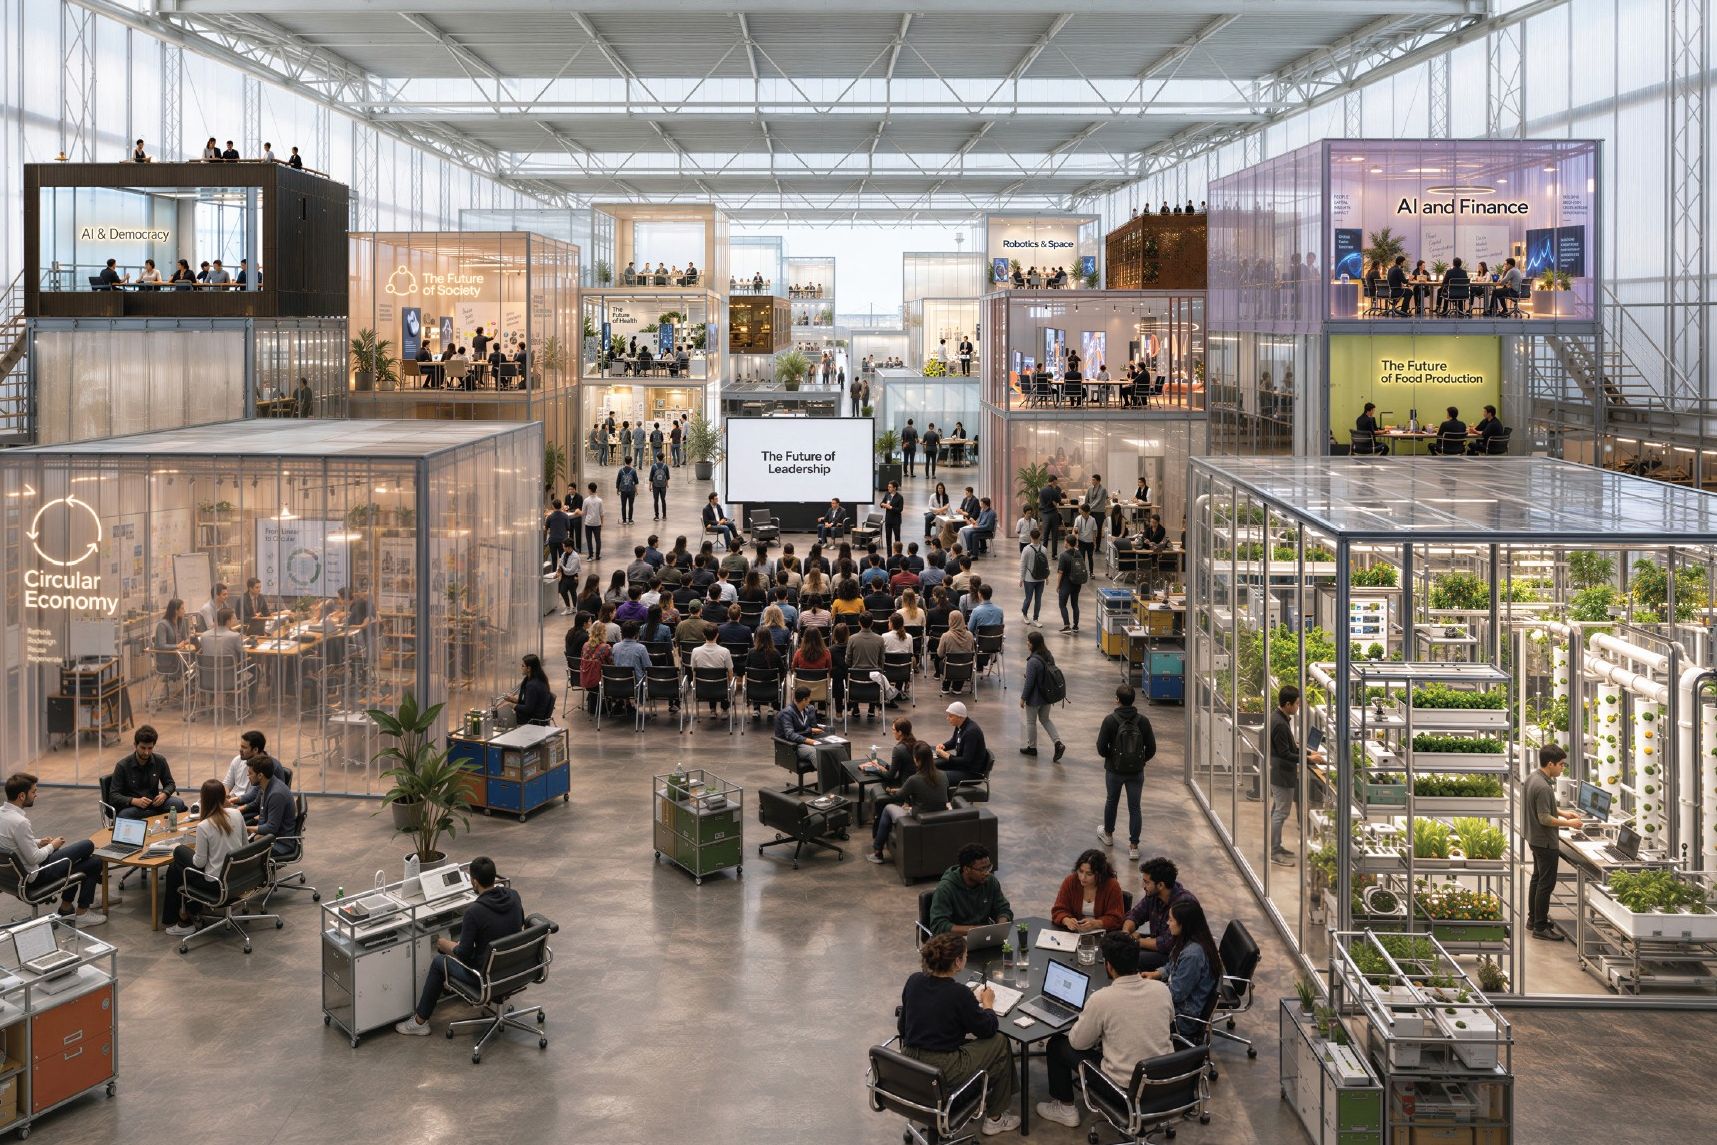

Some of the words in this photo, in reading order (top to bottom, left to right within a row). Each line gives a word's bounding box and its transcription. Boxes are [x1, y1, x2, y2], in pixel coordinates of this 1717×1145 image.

[1397, 198, 1417, 214] AI
[1422, 198, 1454, 214] and
[1459, 198, 1529, 214] Finance
[81, 228, 94, 240] AI
[97, 228, 106, 240] &
[109, 228, 170, 243] Democracy
[1003, 240, 1039, 248] Robotics
[1040, 240, 1047, 248] &
[1048, 240, 1074, 250] Space
[423, 273, 444, 284] The
[447, 273, 485, 284] Future
[422, 285, 436, 296] of
[437, 285, 481, 298] Society
[1381, 360, 1405, 371] The
[1407, 360, 1448, 371] Future
[1380, 373, 1393, 384] of
[1395, 373, 1423, 384] Food
[1425, 373, 1484, 384] Production
[761, 450, 783, 462] The
[785, 450, 822, 462] Future
[824, 450, 836, 462] of
[768, 463, 831, 476] Leadership
[264, 527, 281, 535] Fro
[24, 570, 101, 589] Circular
[25, 590, 118, 615] Economy
